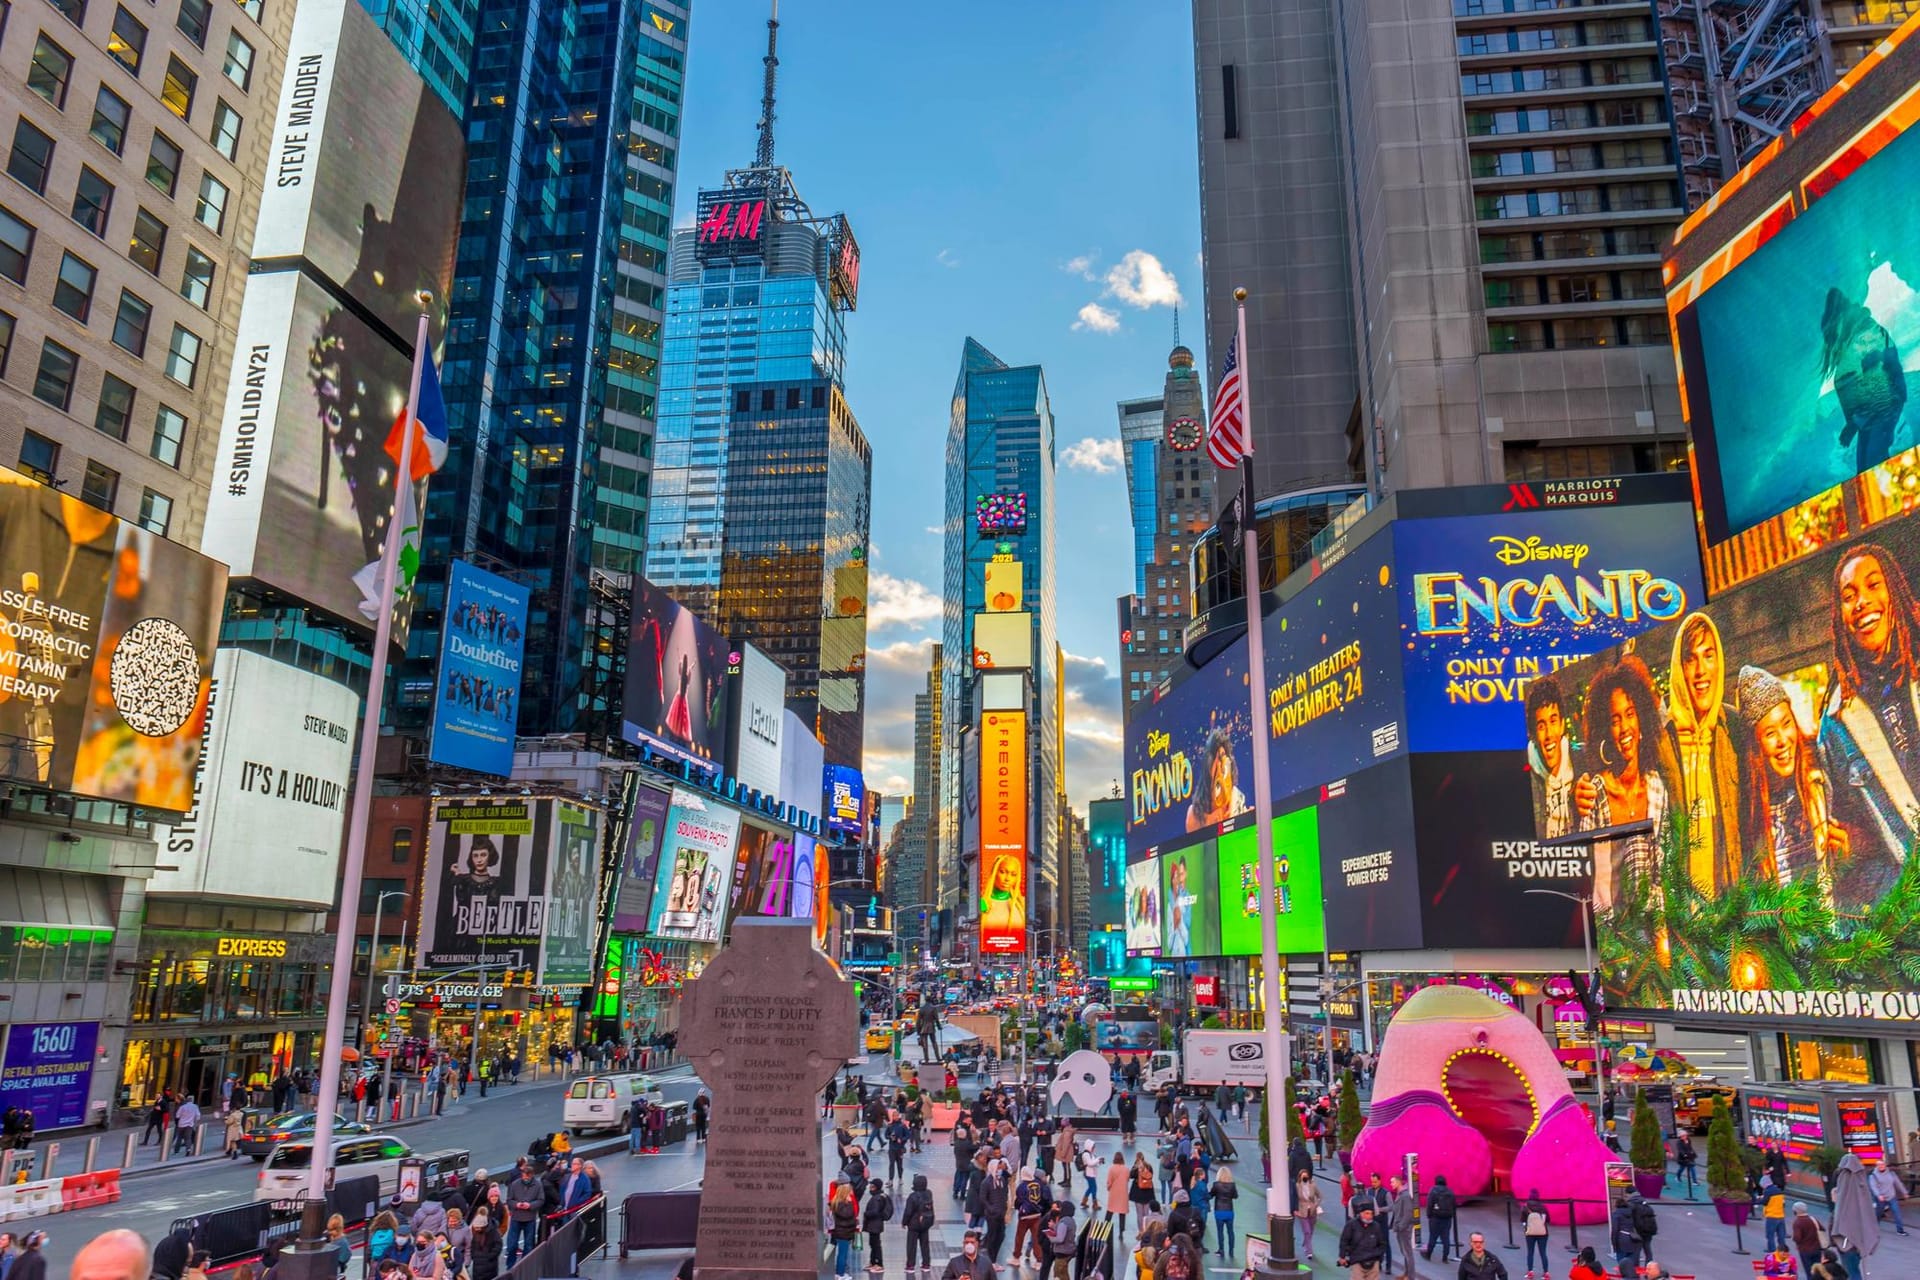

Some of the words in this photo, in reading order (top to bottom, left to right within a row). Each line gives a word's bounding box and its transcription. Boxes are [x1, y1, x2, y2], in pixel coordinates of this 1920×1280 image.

[287, 53, 323, 128] MADDEN
[277, 131, 309, 188] STEVE
[701, 200, 765, 244] H&M
[228, 344, 271, 496] #SMHOLIDAY21
[1545, 478, 1622, 492] MARRIOTT
[1546, 491, 1615, 504] MARQUIS
[992, 554, 1014, 564] 2021
[1489, 536, 1589, 568] Disney
[0, 590, 90, 631] SSLE-FREE
[1413, 568, 1688, 636] ENCANTO
[449, 634, 520, 672] Doubtfire
[1446, 656, 1506, 677] ONLY
[1514, 655, 1540, 675] IN
[1546, 653, 1592, 674] TH
[727, 665, 741, 675] LG
[1271, 678, 1294, 709] ONLY
[1295, 671, 1307, 695] IN
[1308, 639, 1361, 687] THEATERS
[0, 674, 60, 703] ERAPY
[1271, 679, 1342, 740] NOVEMBER
[1343, 665, 1363, 703] 24
[303, 714, 327, 737] STEVE
[240, 760, 274, 796] IT'S
[276, 768, 289, 799] A
[292, 772, 342, 812] HOLIDAY
[997, 728, 1009, 836] FREQUENCY
[1132, 750, 1193, 825] ENCANTO
[439, 806, 458, 819] TIMES
[459, 806, 484, 819] SQUARE
[486, 806, 500, 818] CAN
[501, 805, 527, 817] REALLY
[677, 821, 708, 842] SOUVENIR
[709, 829, 729, 849] PHOTO
[1342, 854, 1379, 873] EXPERIENCE
[1379, 850, 1392, 866] THE
[1508, 860, 1582, 878] POWER
[763, 840, 794, 918] 21
[1347, 870, 1370, 887] POWER
[1370, 868, 1378, 883] OF
[455, 896, 543, 936] BEETLE
[217, 938, 287, 958] EXPRESS
[477, 954, 496, 963] GOOD
[382, 985, 424, 996] GFTS
[433, 984, 504, 998] LUGGAGE
[1674, 989, 1786, 1015] AMERICAN
[1796, 991, 1874, 1017] EAGLE
[714, 1007, 764, 1019] FRANCIS
[780, 1008, 822, 1020] DUFFY
[32, 1025, 71, 1053] 1560
[726, 1036, 768, 1046] CATHOLIC
[774, 1037, 806, 1047] PRIEST
[1, 1078, 31, 1091] SPACE
[31, 1074, 78, 1089] AVAILABLE
[733, 1107, 752, 1116] LIFE
[753, 1107, 766, 1116] OF
[768, 1107, 804, 1117] SERVICE
[718, 1125, 740, 1134] GOD
[742, 1126, 761, 1135] AND
[763, 1126, 806, 1135] COUNTRY
